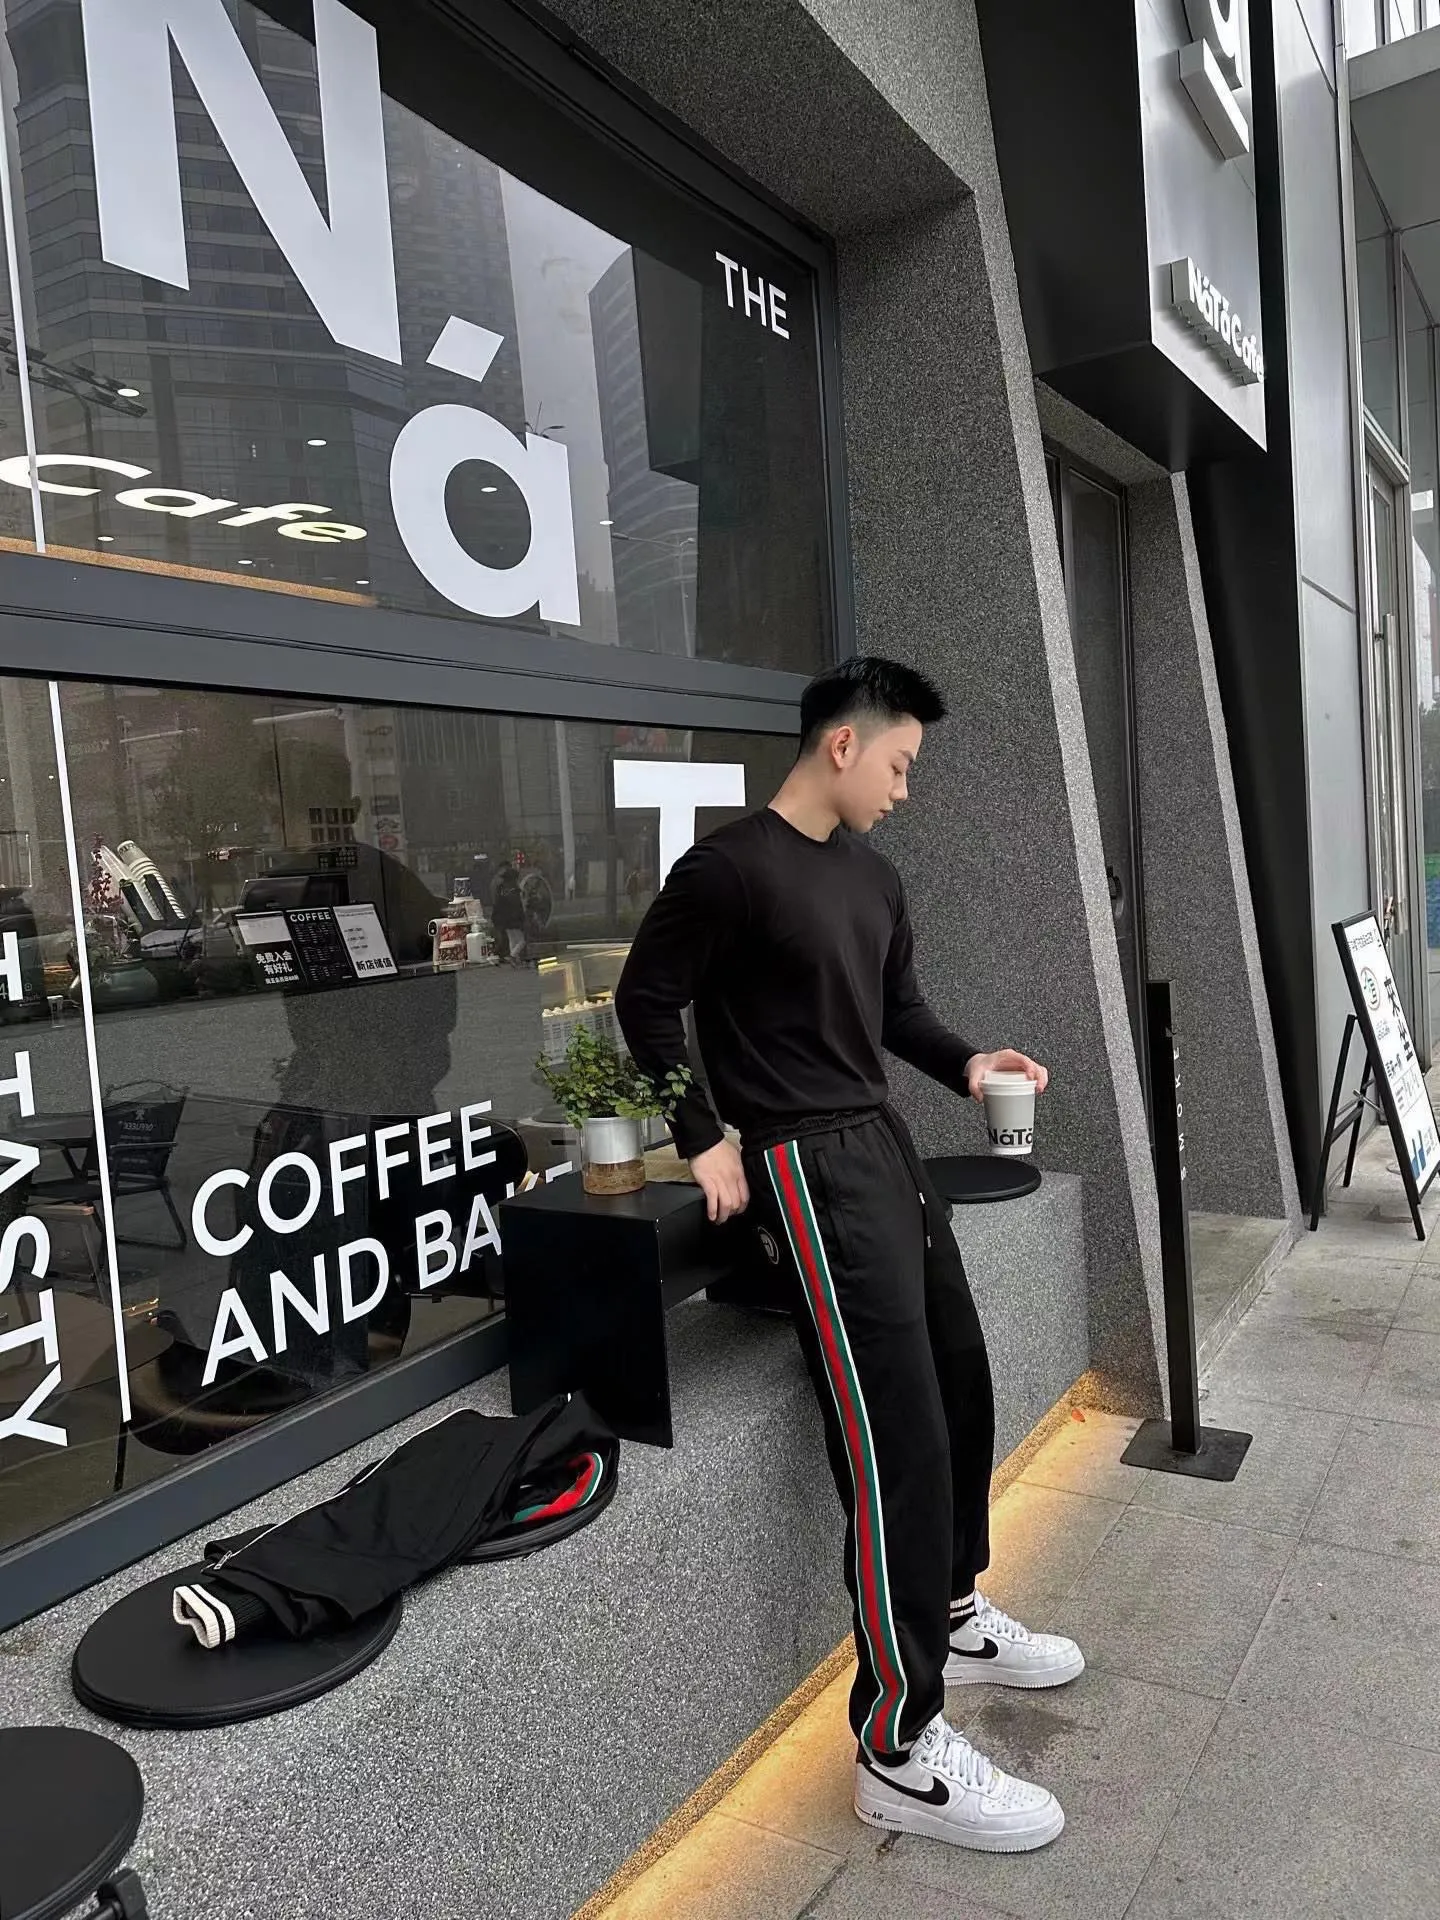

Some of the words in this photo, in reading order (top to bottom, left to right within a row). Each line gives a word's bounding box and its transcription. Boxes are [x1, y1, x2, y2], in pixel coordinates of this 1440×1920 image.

[715, 251, 790, 340] THE
[0, 454, 367, 542] Cafe
[290, 911, 331, 922] COFFEE
[264, 961, 293, 975] 有好礼
[191, 1100, 497, 1257] COFFEE
[201, 1237, 390, 1387] AND
[871, 1811, 884, 1821] AIR
